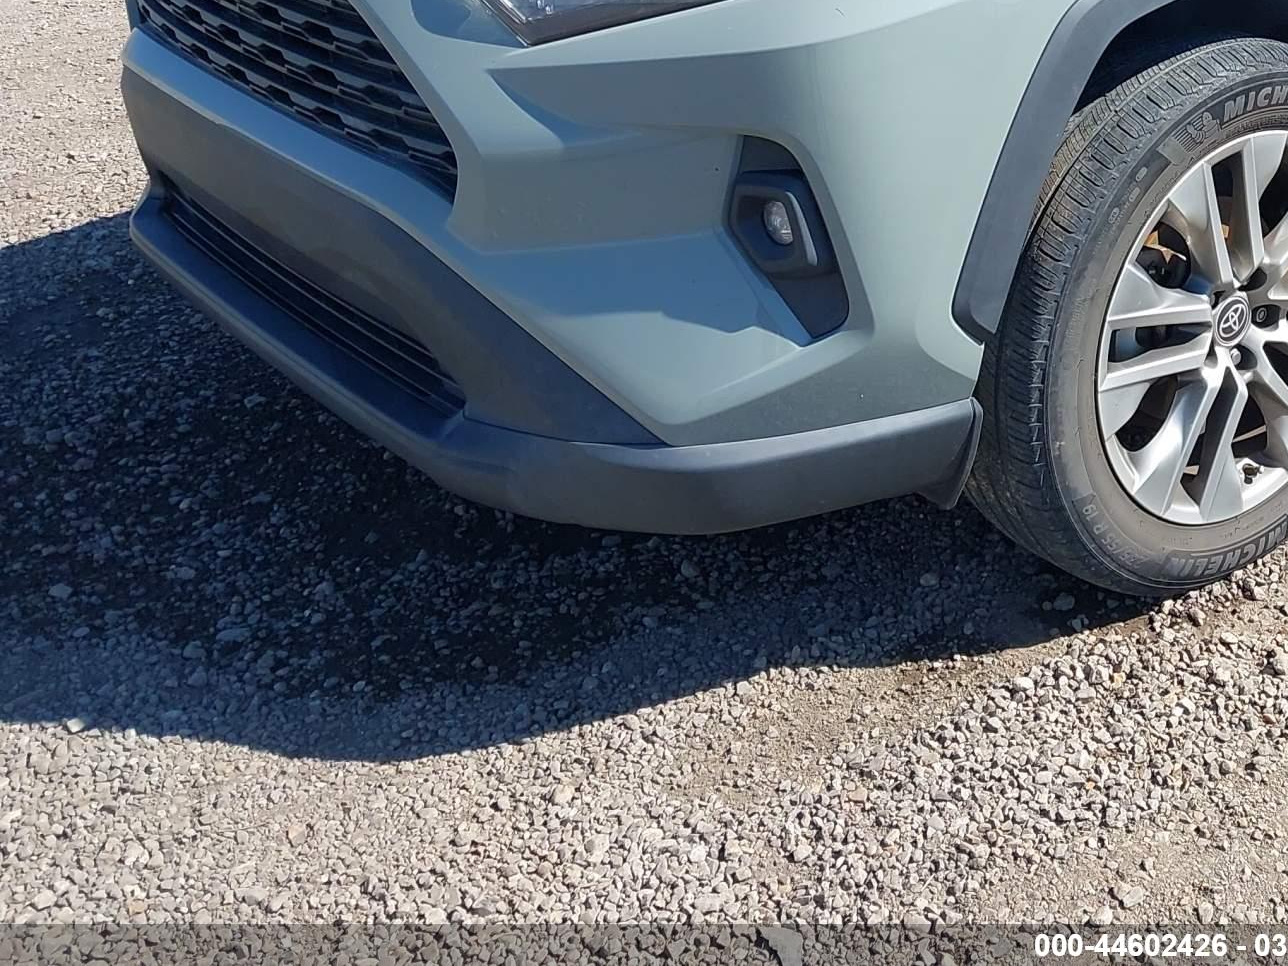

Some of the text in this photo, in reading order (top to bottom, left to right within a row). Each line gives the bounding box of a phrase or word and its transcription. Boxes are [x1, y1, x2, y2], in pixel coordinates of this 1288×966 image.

[1081, 504, 1100, 522] 19
[1092, 525, 1108, 536] R
[1168, 519, 1288, 578] MICHELIN
